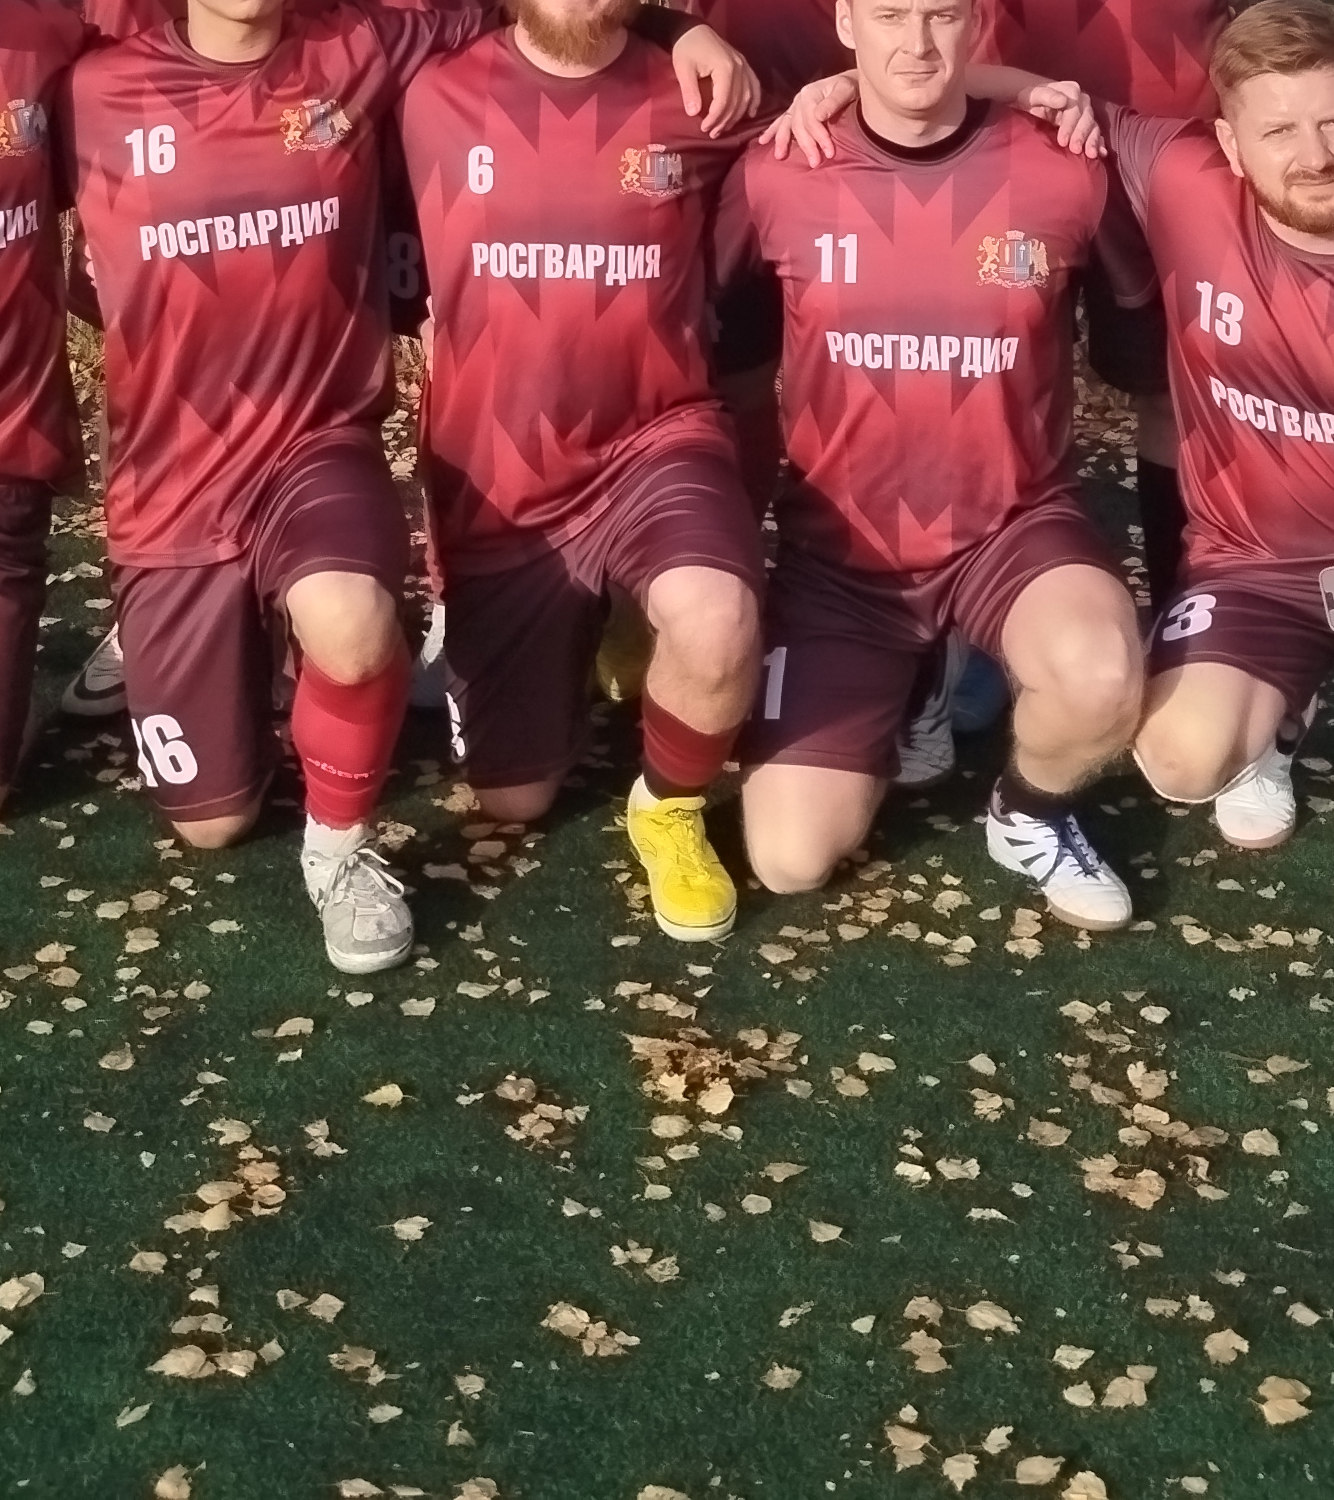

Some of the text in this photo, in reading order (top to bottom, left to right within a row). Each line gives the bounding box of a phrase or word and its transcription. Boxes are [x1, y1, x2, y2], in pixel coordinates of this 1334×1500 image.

[125, 125, 176, 177] 16
[468, 145, 494, 195] 6
[140, 196, 340, 261] РОСГВАРДИЯ
[471, 242, 661, 286] РОСГВАРДИЯ
[814, 233, 858, 284] 11
[1196, 280, 1244, 346] 13
[825, 331, 1019, 378] РОСГВАРДИЯ
